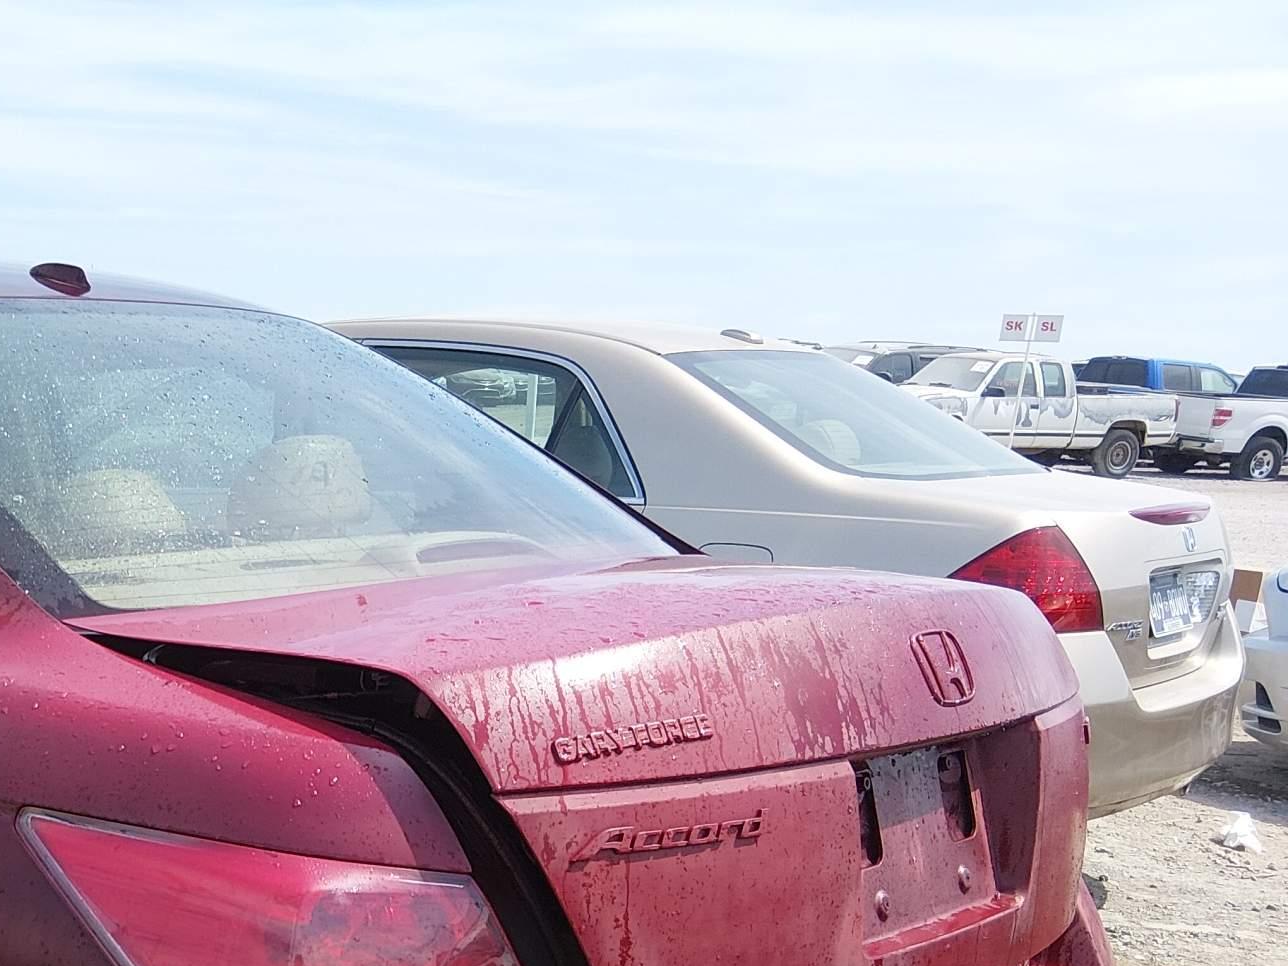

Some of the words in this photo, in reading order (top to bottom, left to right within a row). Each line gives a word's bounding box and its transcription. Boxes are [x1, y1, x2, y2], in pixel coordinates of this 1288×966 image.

[1005, 320, 1024, 332] SK
[1040, 321, 1057, 332] SL
[569, 808, 769, 866] Accord
